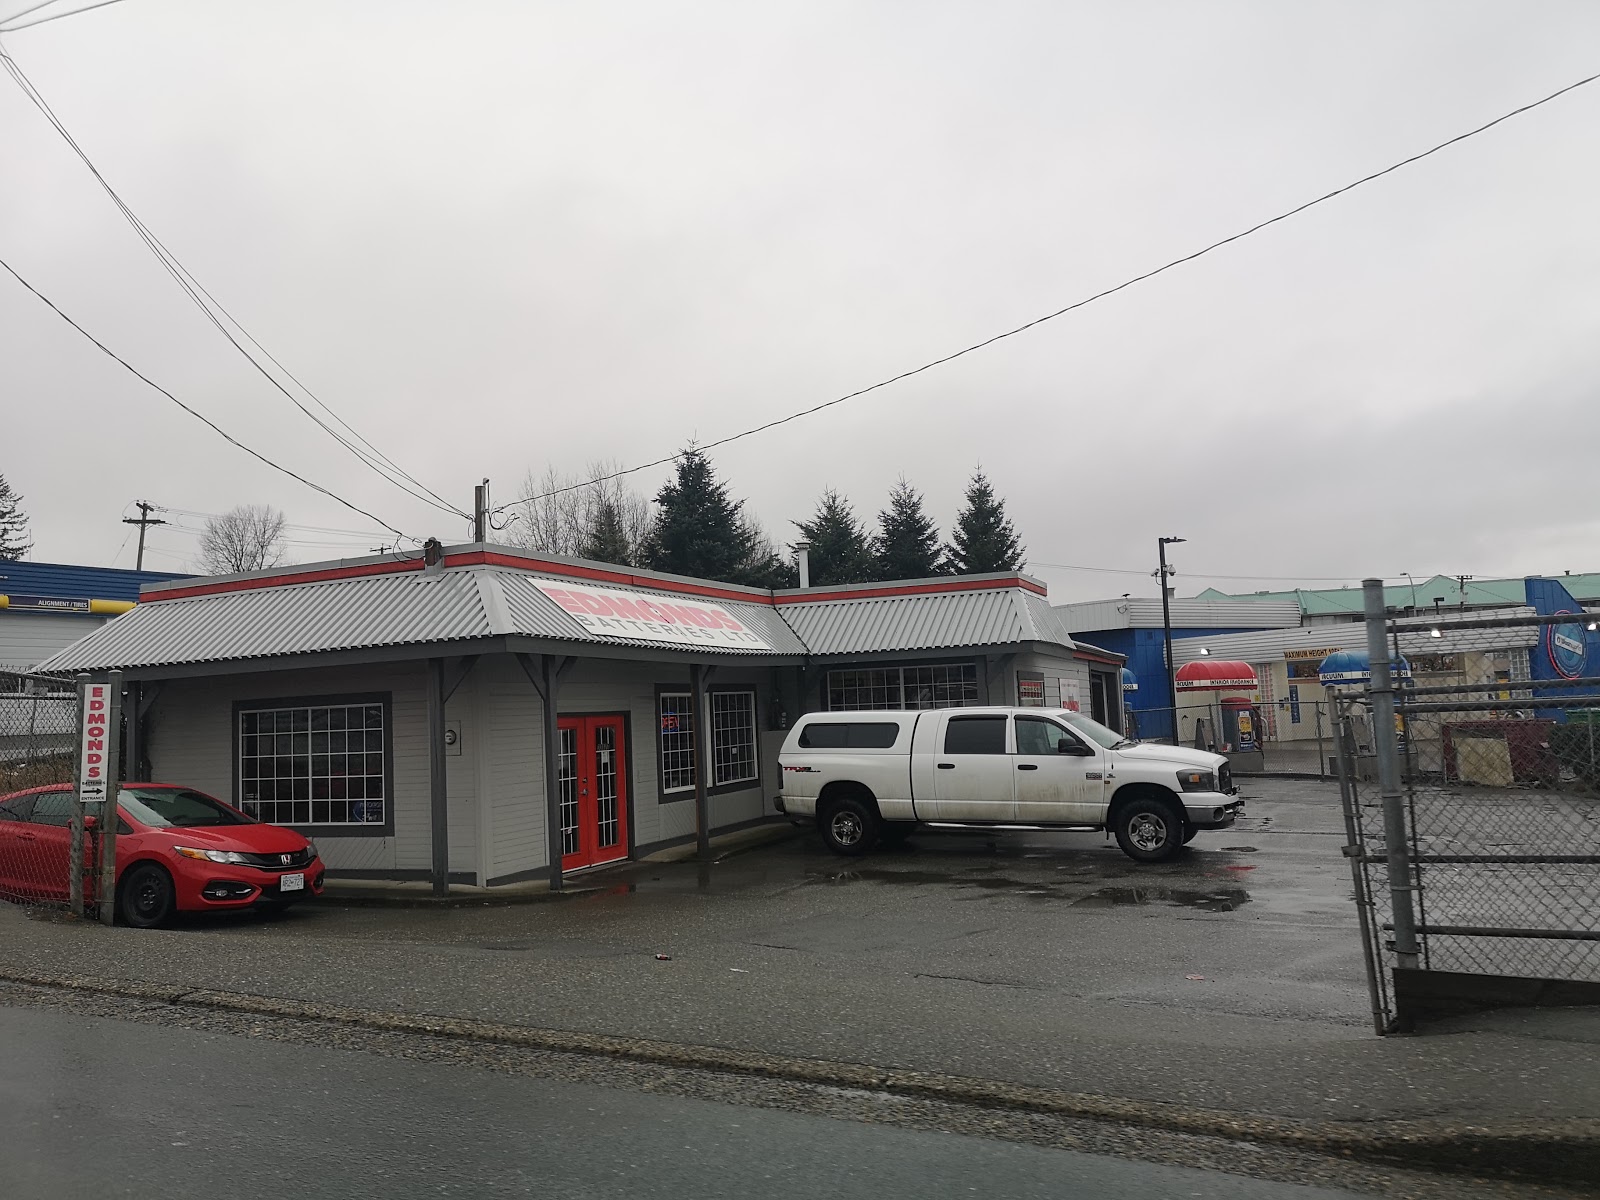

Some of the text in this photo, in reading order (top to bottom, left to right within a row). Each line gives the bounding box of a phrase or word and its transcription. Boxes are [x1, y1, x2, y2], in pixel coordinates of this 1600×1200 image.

[540, 587, 743, 632] EDMONDS
[573, 614, 759, 642] BATTERIES LTD
[1284, 650, 1308, 659] MAXIMUM
[1309, 649, 1328, 657] HEIGHT
[87, 687, 106, 778] EDMONDS
